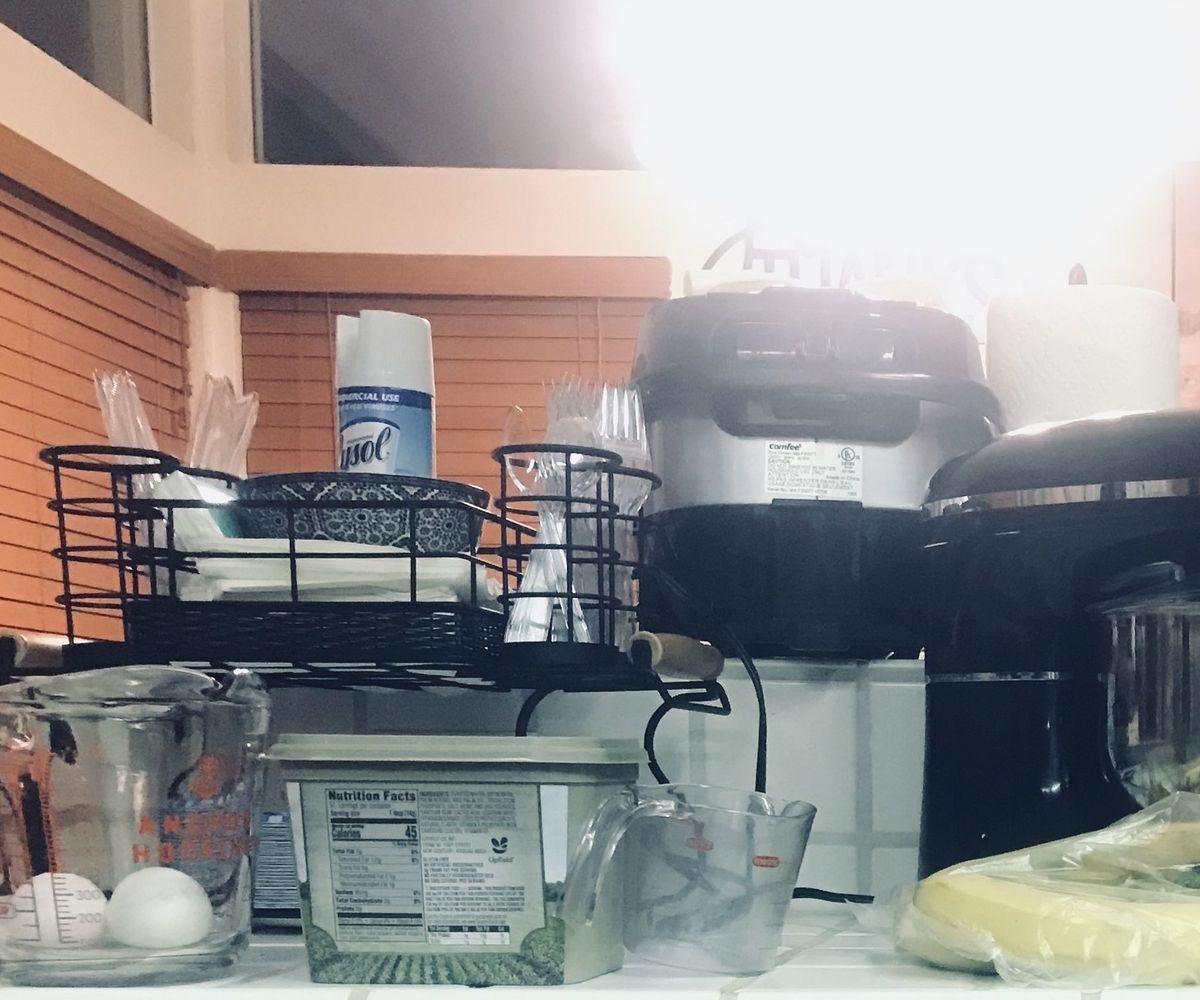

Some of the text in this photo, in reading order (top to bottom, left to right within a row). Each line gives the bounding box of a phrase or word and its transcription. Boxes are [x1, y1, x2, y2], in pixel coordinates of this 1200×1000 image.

[381, 394, 400, 403] USE
[339, 426, 391, 471] ysol
[328, 790, 416, 801] Nutrition Facts
[332, 825, 418, 839] Calories 45
